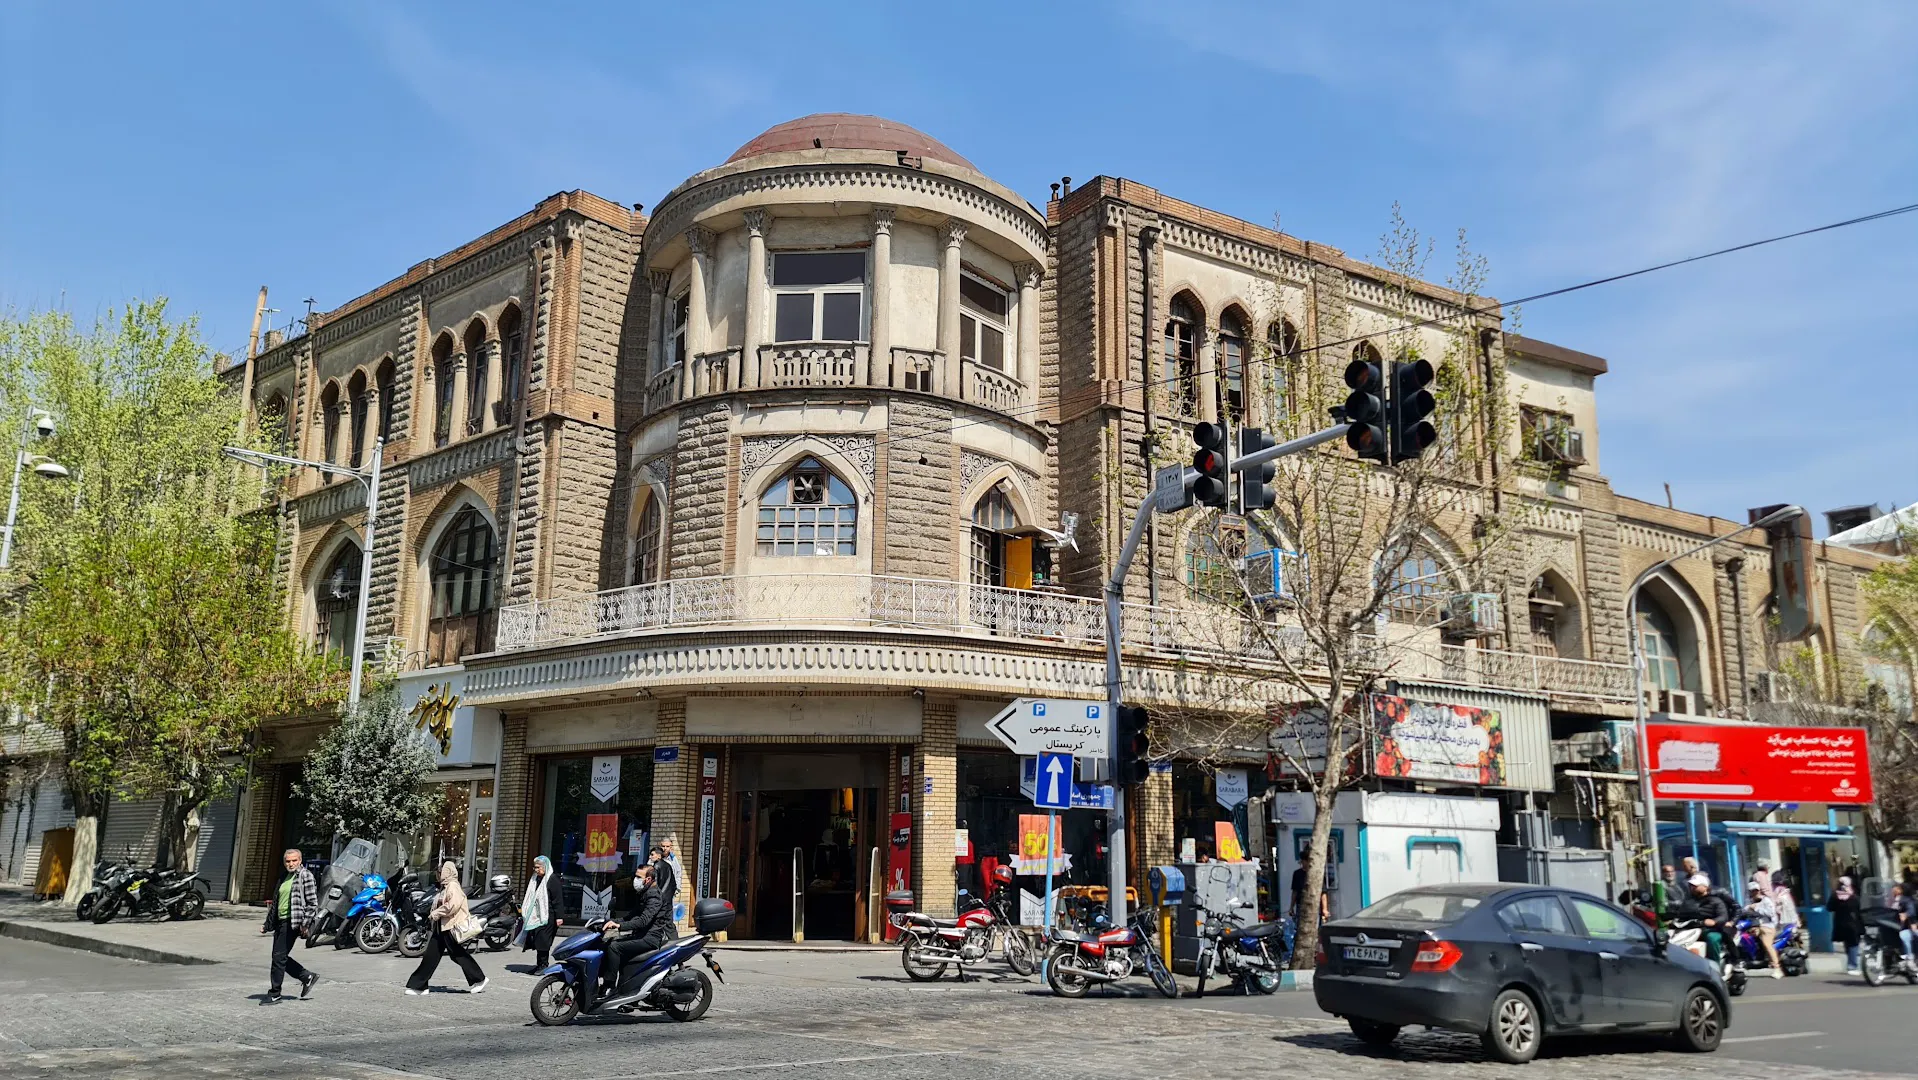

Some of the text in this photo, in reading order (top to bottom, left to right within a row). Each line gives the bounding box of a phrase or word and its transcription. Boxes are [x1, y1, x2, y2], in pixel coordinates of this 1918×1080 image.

[1029, 724, 1101, 739] پارکینگ عمومی
[1045, 739, 1086, 751] کریستال
[593, 775, 618, 783] SARABARA
